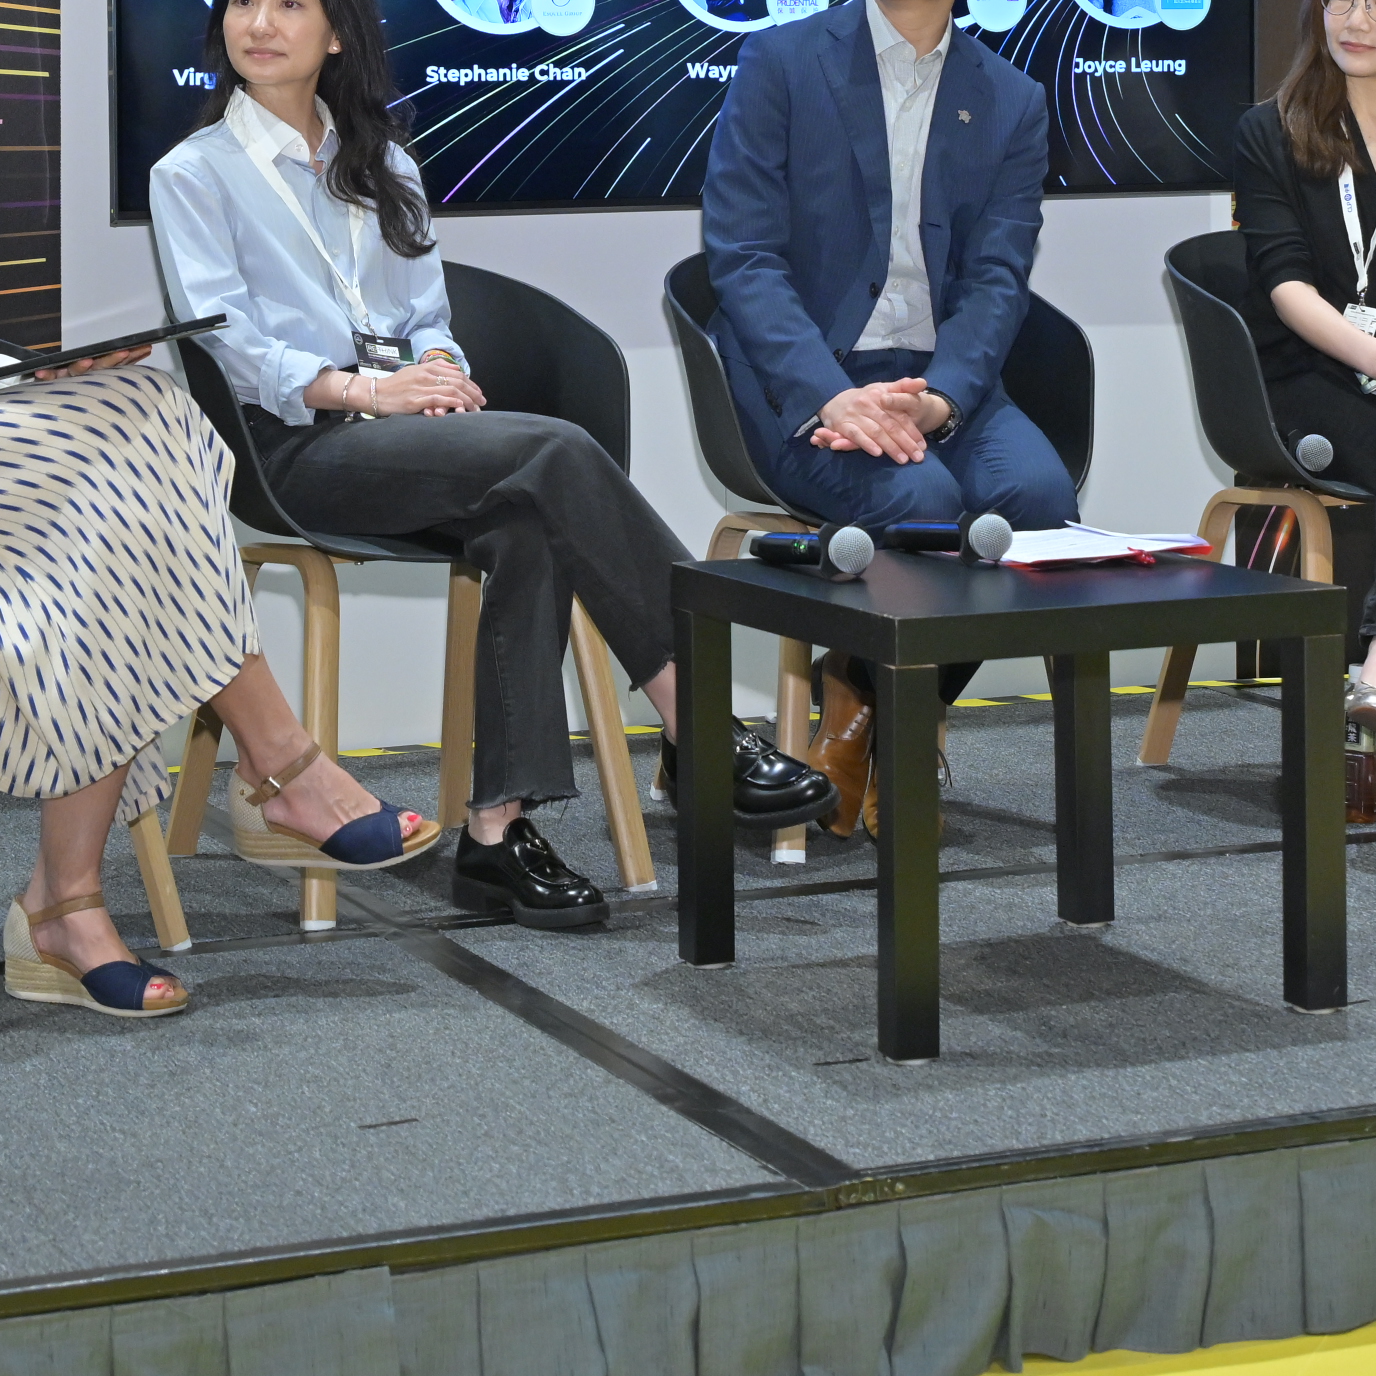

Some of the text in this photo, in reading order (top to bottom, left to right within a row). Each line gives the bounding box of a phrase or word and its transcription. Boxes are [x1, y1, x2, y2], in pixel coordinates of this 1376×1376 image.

[425, 63, 586, 86] Stephanie Chan
[1074, 57, 1186, 77] Joyce Leung
